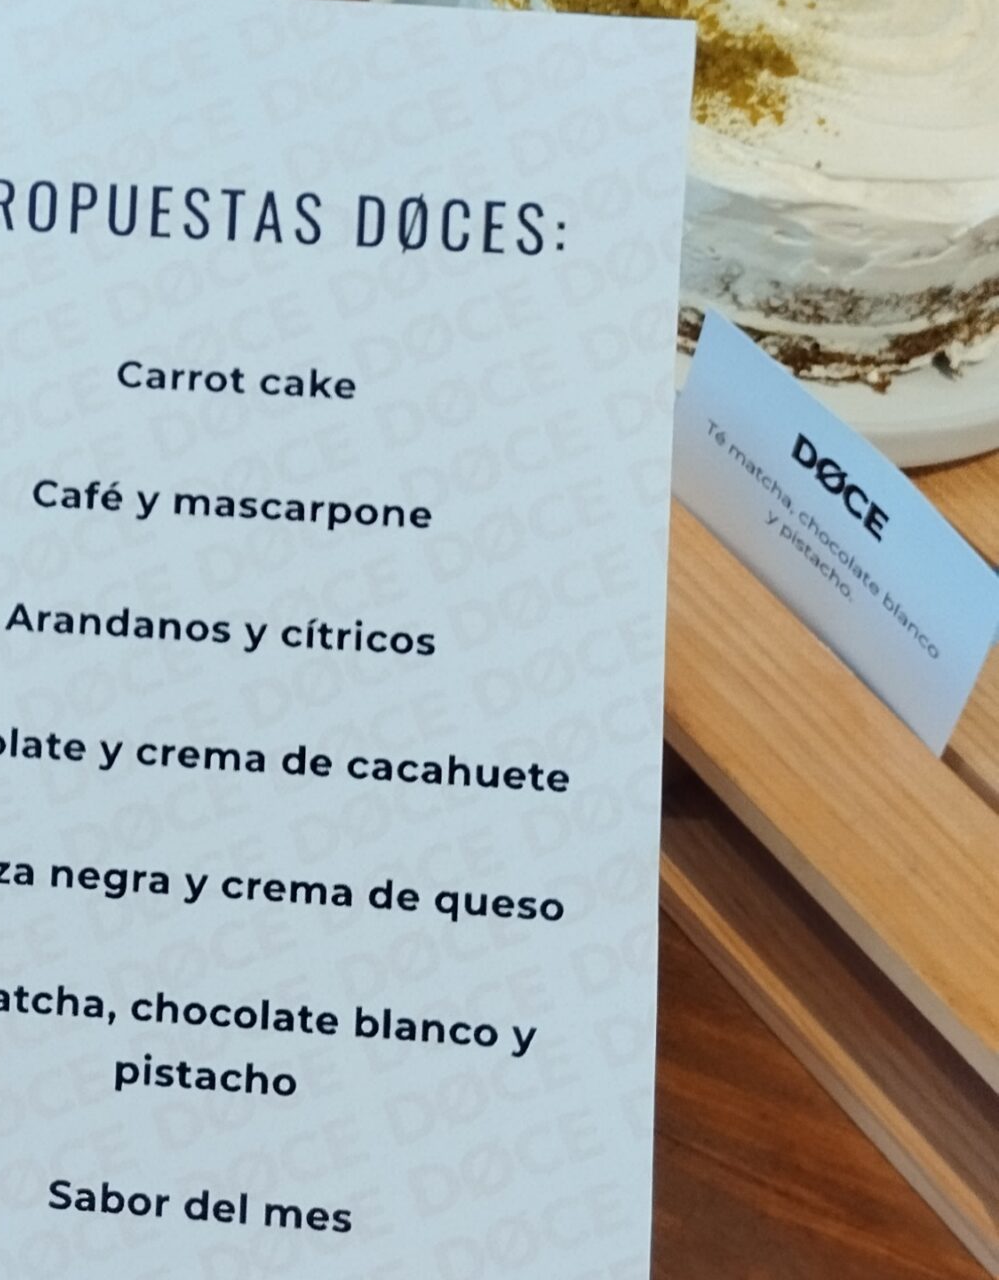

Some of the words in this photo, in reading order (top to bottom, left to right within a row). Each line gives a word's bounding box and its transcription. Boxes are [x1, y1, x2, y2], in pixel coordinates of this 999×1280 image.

[117, 360, 246, 395] Carrot
[259, 367, 357, 400] cake
[32, 478, 123, 512] Café
[135, 490, 161, 521] y
[173, 492, 433, 532] mascarpone
[707, 419, 727, 447] Té
[728, 441, 794, 516] matcha,
[797, 508, 881, 599] chocolate
[882, 590, 940, 661] blanco
[766, 509, 779, 527] y
[778, 522, 856, 605] pistacho.
[4, 602, 232, 644] Arandanos
[243, 622, 268, 654] y
[280, 617, 436, 657] cítricos
[98, 739, 124, 772] y
[135, 742, 266, 773] crema
[281, 744, 333, 778] de
[346, 753, 570, 793] cacahuete
[50, 864, 170, 900] negra
[183, 872, 209, 905] y
[221, 875, 353, 908] crema
[368, 878, 421, 912] de
[434, 890, 565, 923] queso
[130, 991, 339, 1036] chocolate
[354, 1005, 499, 1048] blanco
[510, 1025, 538, 1059] y
[114, 1052, 297, 1097] pistacho
[47, 1179, 171, 1218] Sabor
[183, 1189, 248, 1225] del
[264, 1202, 352, 1234] mes
